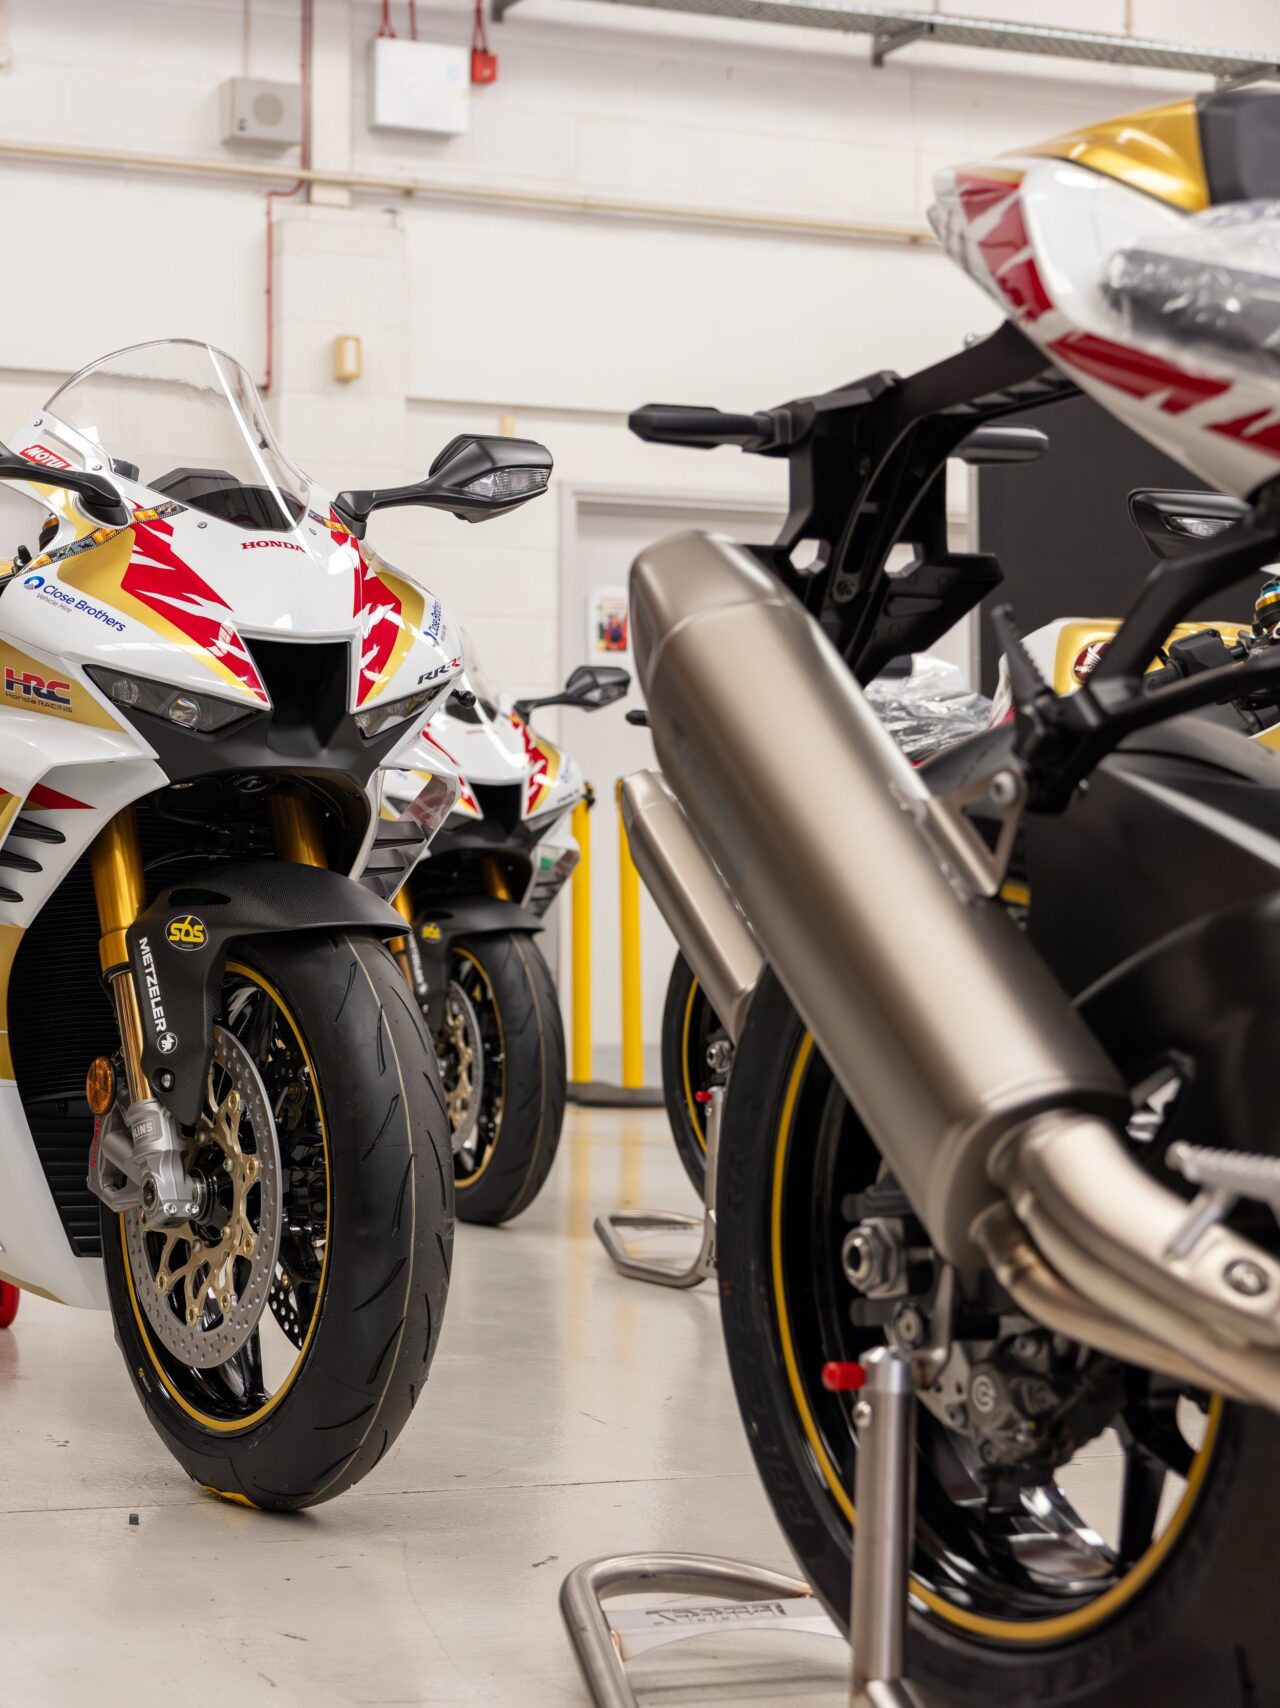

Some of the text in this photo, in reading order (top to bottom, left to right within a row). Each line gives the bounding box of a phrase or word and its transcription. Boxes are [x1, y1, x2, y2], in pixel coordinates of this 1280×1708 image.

[240, 540, 306, 553] HONDA
[36, 592, 73, 614] Vehicle Hire
[43, 584, 126, 632] Close Brothers
[4, 666, 72, 707] HRC
[5, 692, 73, 713] Honda RACING
[138, 936, 167, 1033] METZELER
